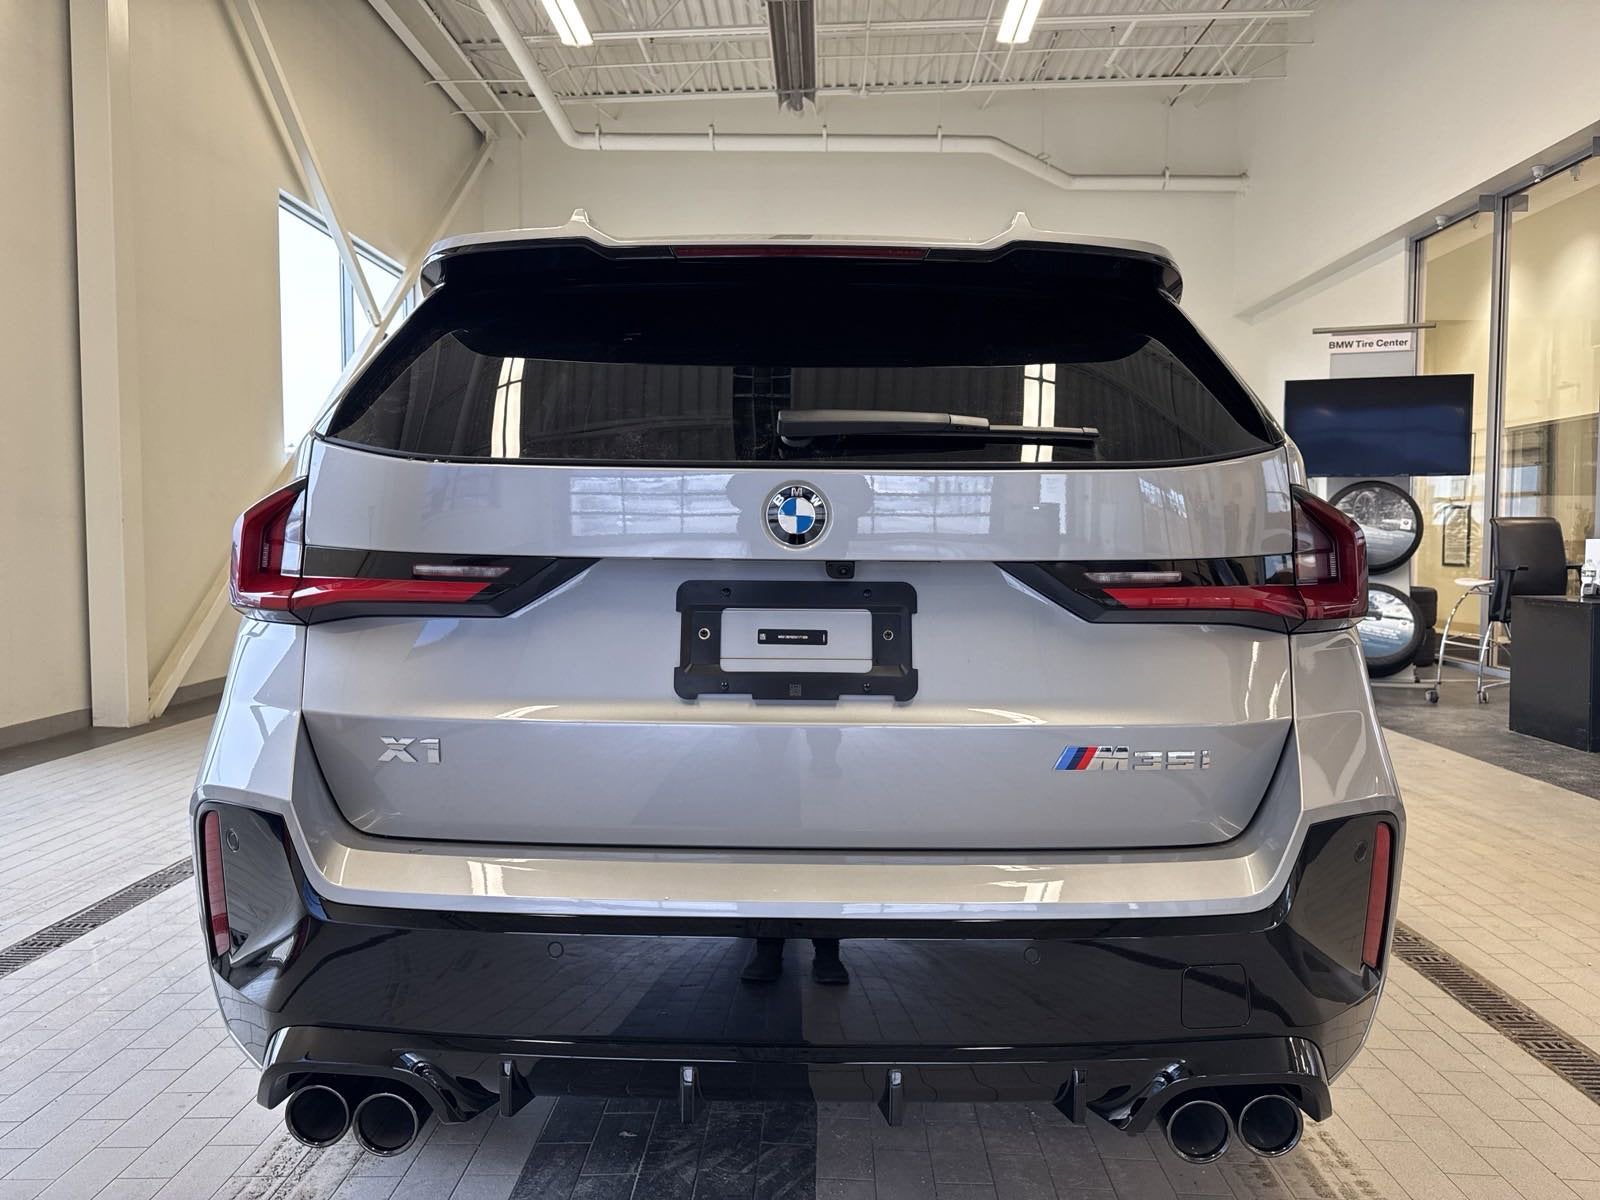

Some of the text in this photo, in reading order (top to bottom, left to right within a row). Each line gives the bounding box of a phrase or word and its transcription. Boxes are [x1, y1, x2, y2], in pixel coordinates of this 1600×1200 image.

[1328, 339, 1409, 349] BMW Tire Center
[773, 487, 823, 507] BMW
[378, 736, 442, 764] X1
[1084, 745, 1211, 771] M35i
